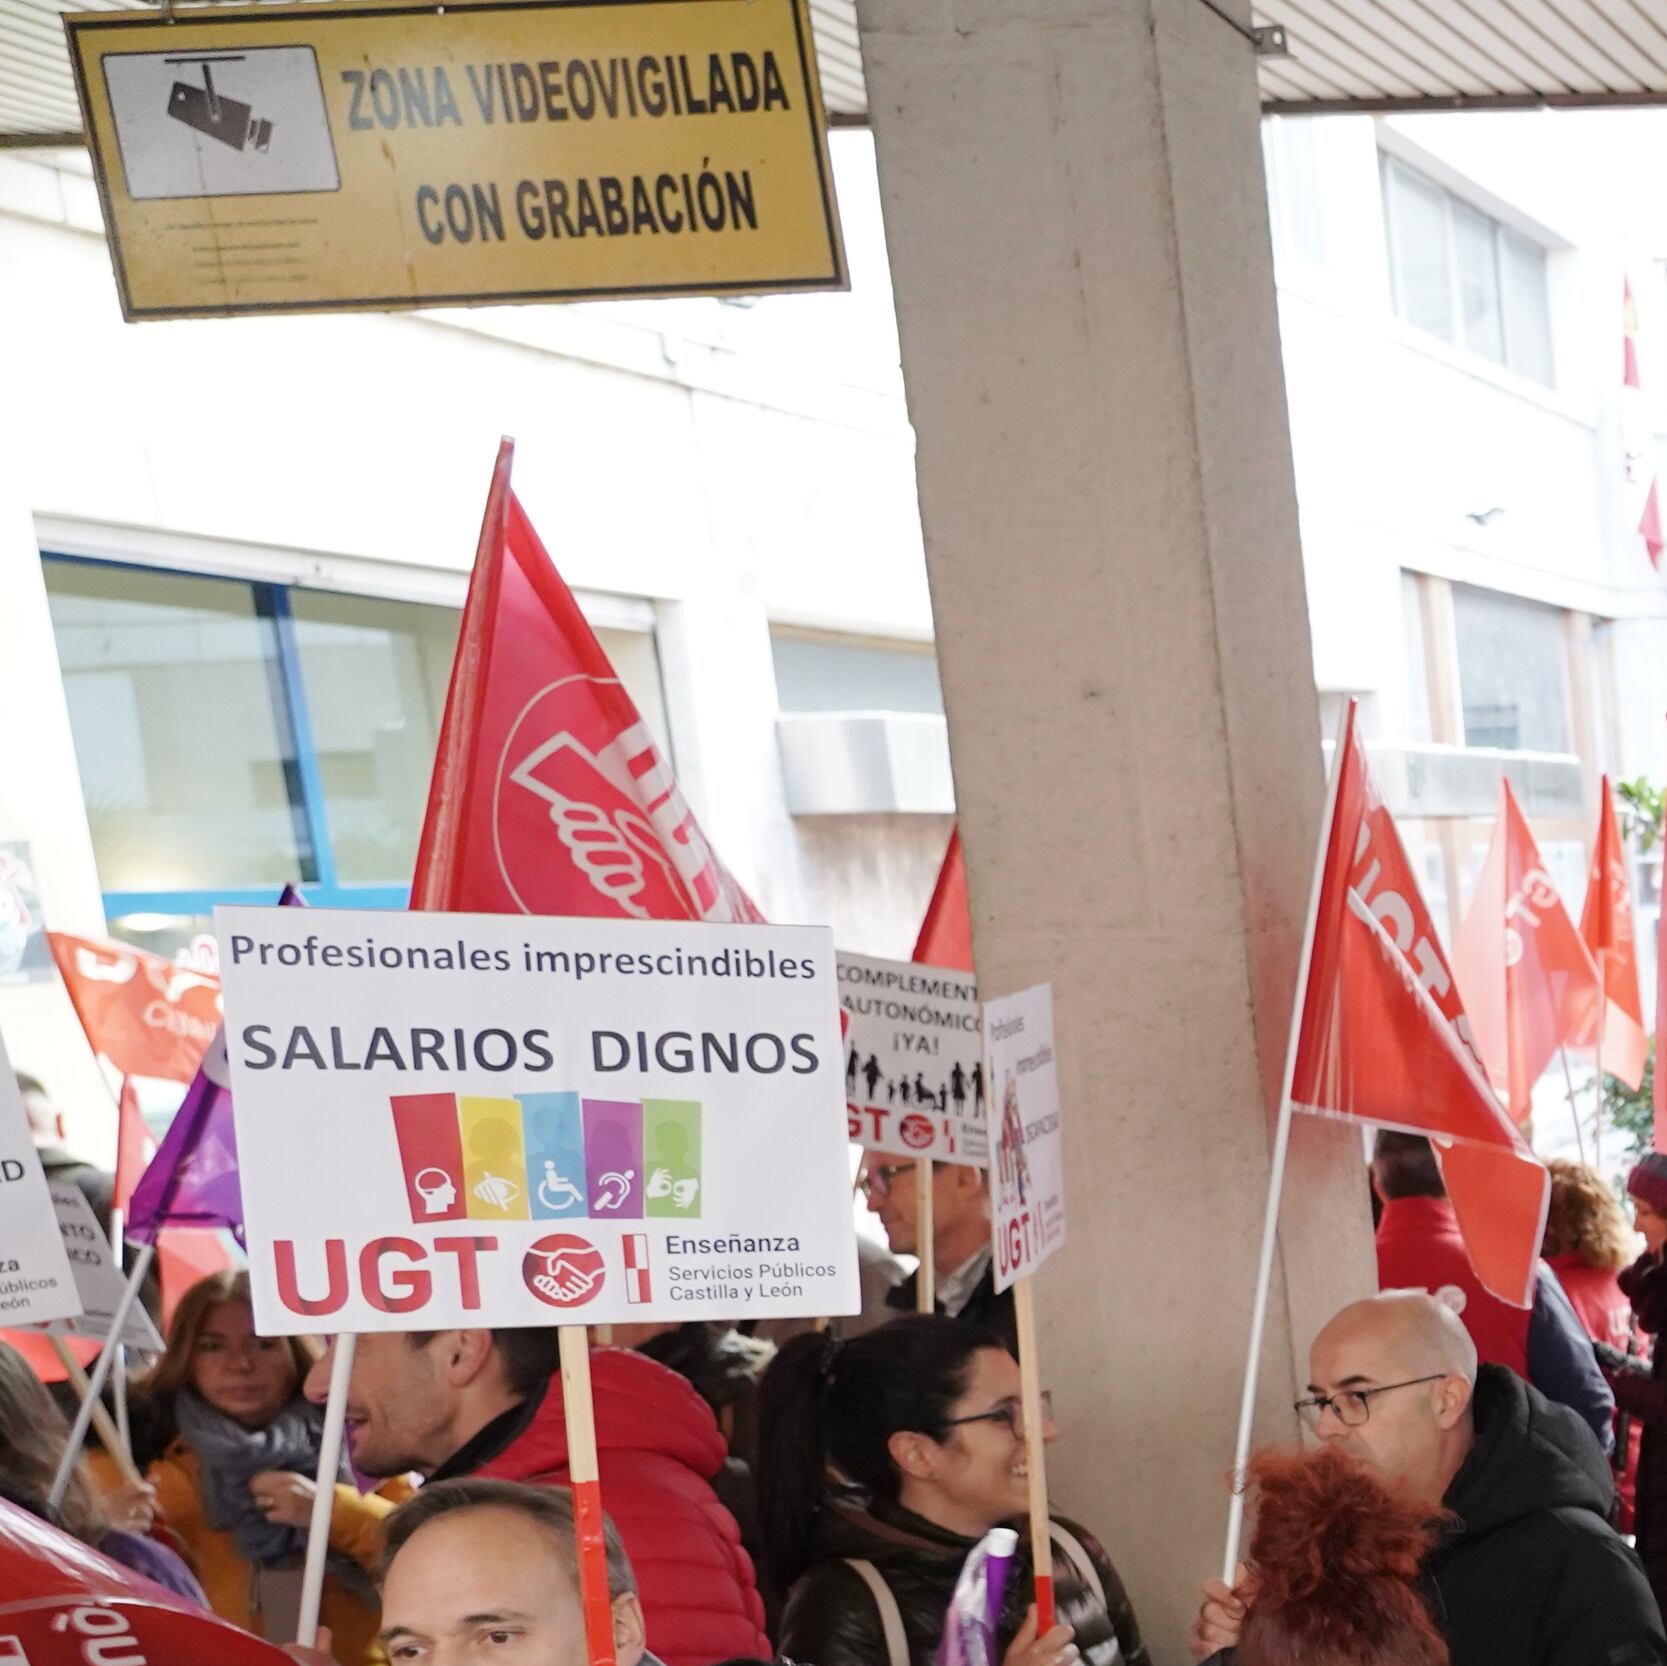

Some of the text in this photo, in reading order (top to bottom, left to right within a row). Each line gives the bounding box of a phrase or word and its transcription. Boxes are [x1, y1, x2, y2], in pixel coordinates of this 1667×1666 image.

[341, 51, 791, 132] ZONA VIDEOVIGILADA
[417, 158, 759, 246] CON GRABACIÓN
[231, 935, 816, 985] Profesionales imprescindibles
[243, 1022, 821, 1075] SALARIOS DIGNOS
[665, 1233, 800, 1256] Enseñanza
[273, 1236, 499, 1316] UGT
[669, 1261, 836, 1281] Servicios Públicos
[670, 1281, 803, 1303] Castilla y León
